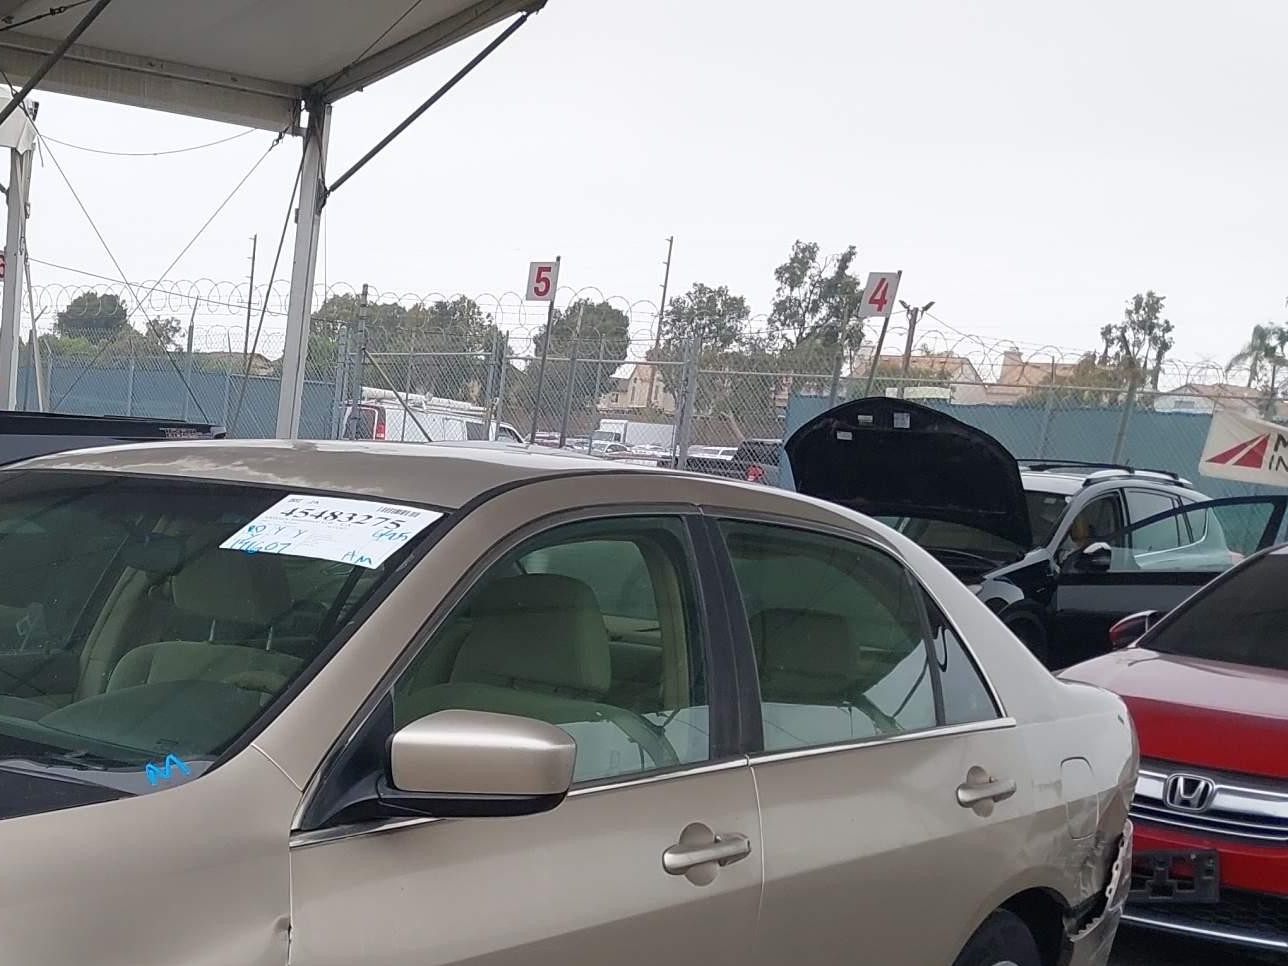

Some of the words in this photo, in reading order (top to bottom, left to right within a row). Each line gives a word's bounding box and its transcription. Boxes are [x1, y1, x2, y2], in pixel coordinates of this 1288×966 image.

[534, 266, 552, 297] 5
[868, 277, 889, 312] 4
[280, 507, 406, 529] 45483275
